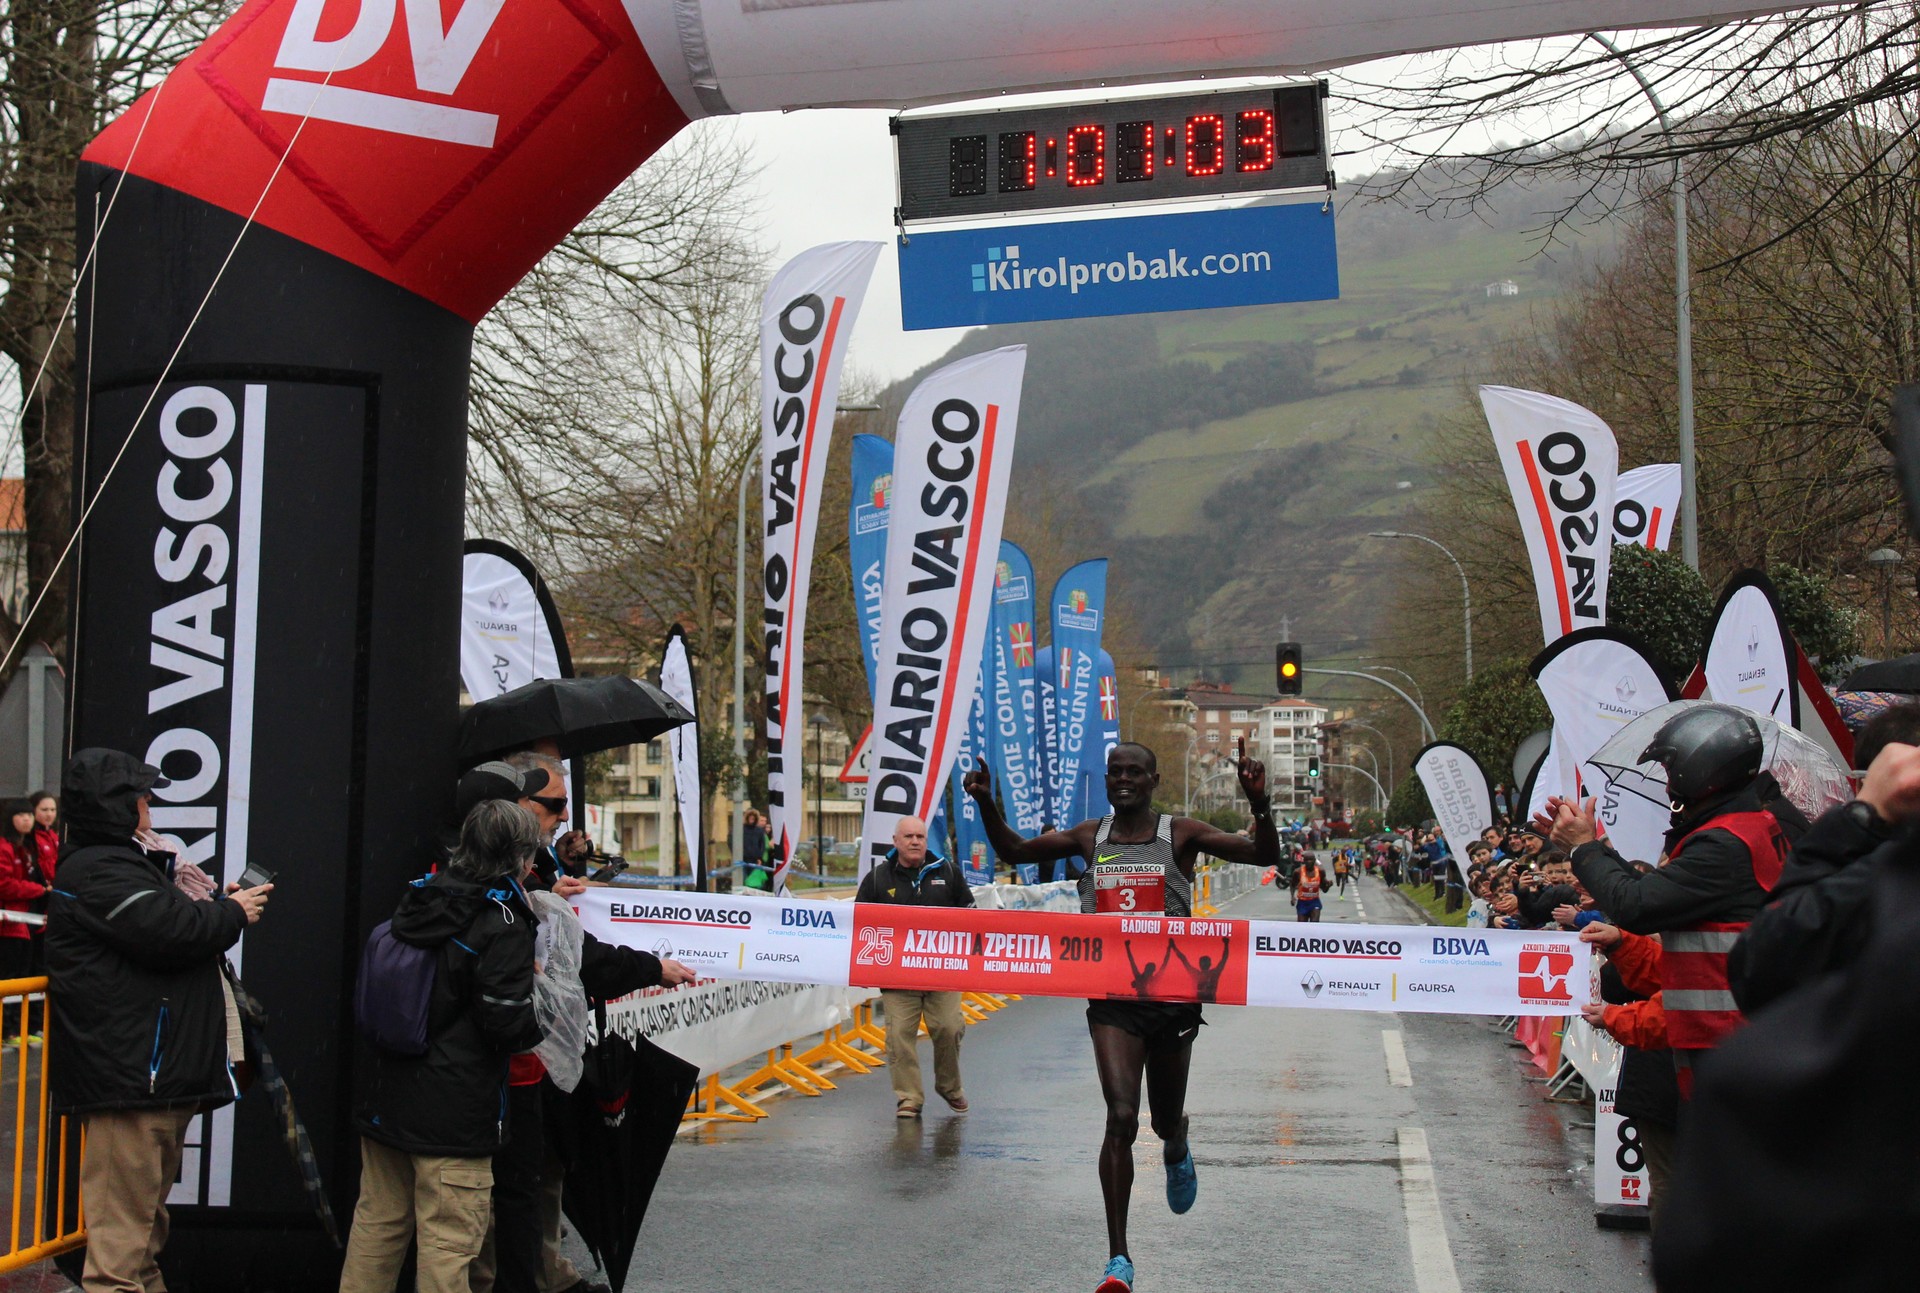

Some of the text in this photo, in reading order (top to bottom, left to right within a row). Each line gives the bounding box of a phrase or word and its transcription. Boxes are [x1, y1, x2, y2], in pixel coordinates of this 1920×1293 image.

[273, 0, 502, 95] DV
[1027, 111, 1272, 185] 1:01:03
[988, 246, 1271, 294] Kirolprobak.com
[767, 293, 825, 536] VASCO
[907, 398, 980, 595] VASCO
[148, 385, 236, 715] VASCO
[873, 606, 948, 815] DIARIO
[1067, 649, 1093, 753] COUNTRY
[1096, 866, 1104, 874] EL
[1134, 865, 1161, 873] VASCO
[1119, 888, 1136, 911] 3
[610, 902, 752, 925] EL DIARIO VASCO
[781, 907, 836, 929] BBVA
[767, 928, 848, 941] Creando Oportunidades
[1121, 918, 1232, 937] BADUGU ZER OSPATU!
[678, 948, 729, 959] RENAULT
[856, 926, 895, 966] 25
[1059, 935, 1104, 962] 2018
[1255, 936, 1402, 956] EL DIARIO VASCO
[1432, 937, 1490, 956] BBVA
[755, 952, 801, 963] GAURSA
[901, 955, 969, 971] MARATOI ERDIA
[983, 960, 1052, 975] MEDIO MARATÓN
[1419, 957, 1503, 967] Creando Oportunidades
[1328, 980, 1381, 991] RENAULT
[1328, 989, 1349, 998] Passion
[1358, 990, 1368, 998] life
[1408, 982, 1455, 994] GAURSA
[1599, 1089, 1615, 1102] AZK
[1616, 1117, 1647, 1173] 8
